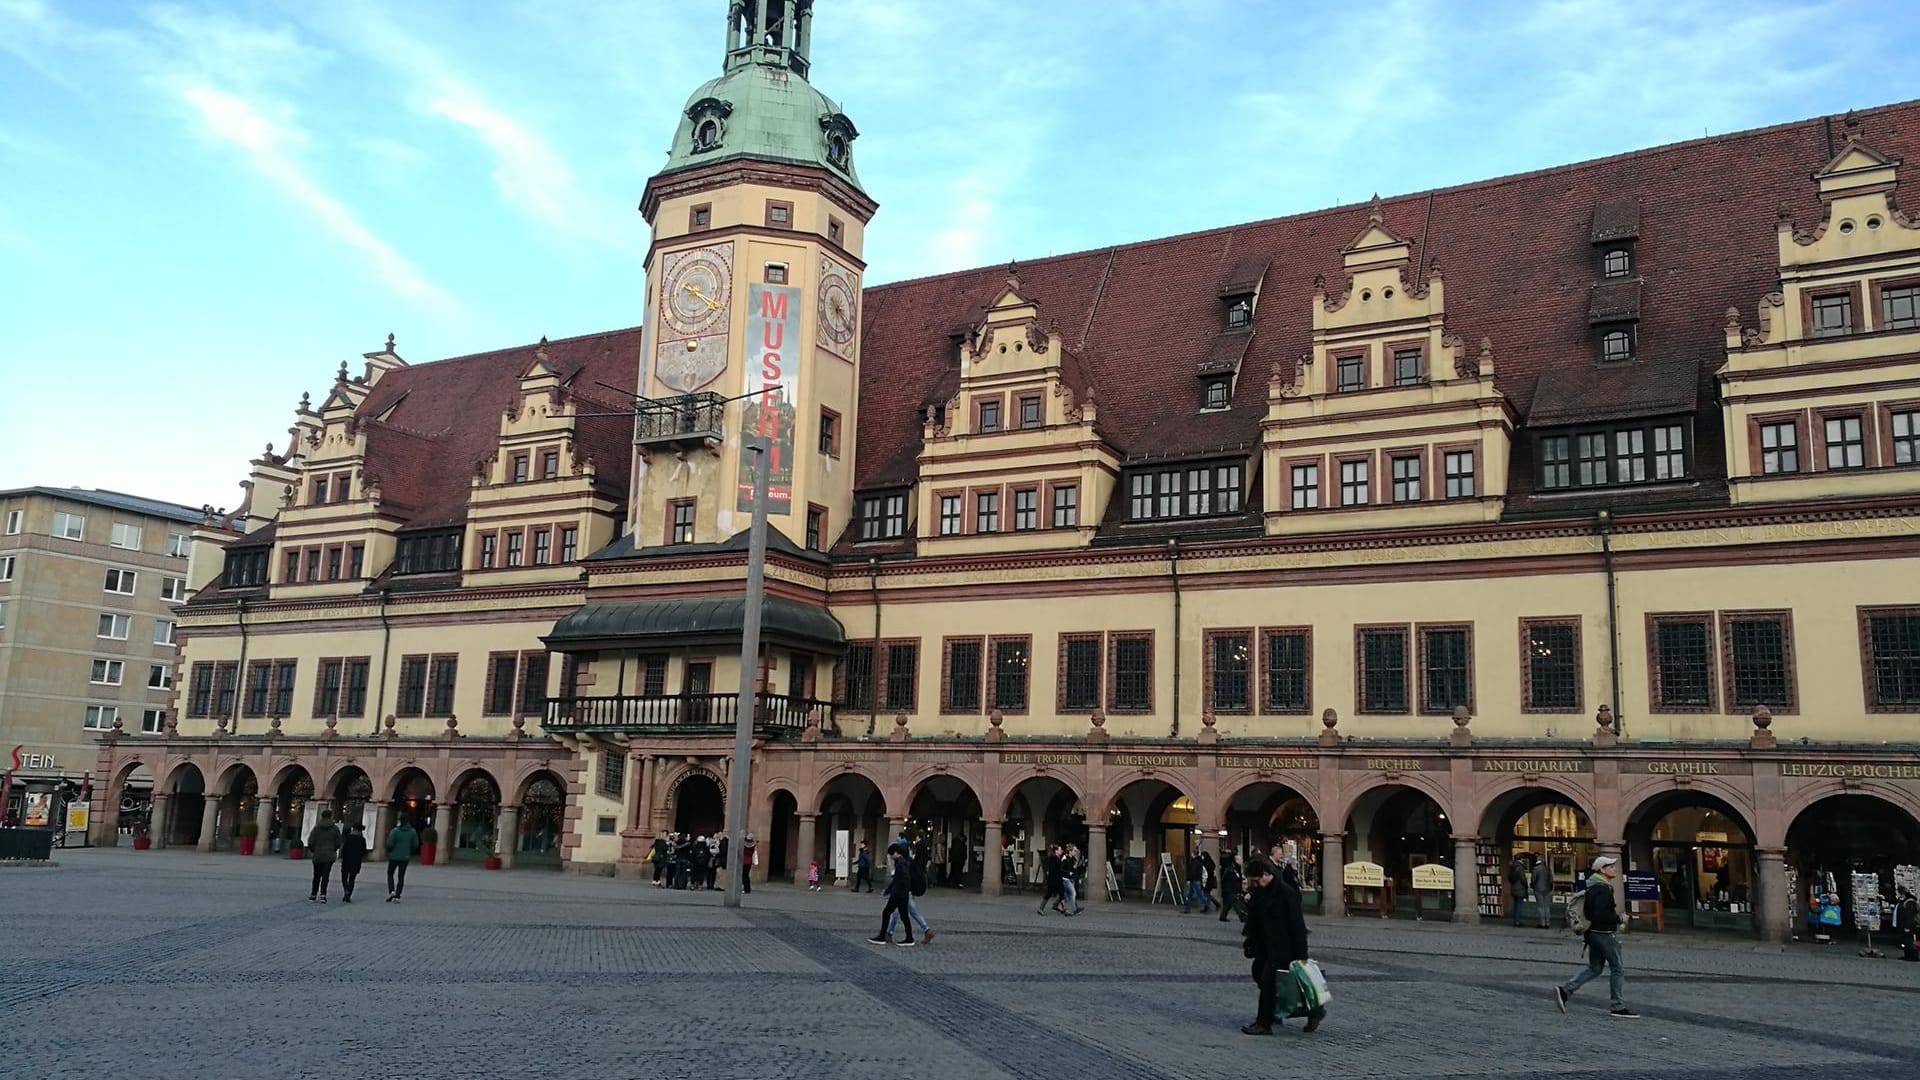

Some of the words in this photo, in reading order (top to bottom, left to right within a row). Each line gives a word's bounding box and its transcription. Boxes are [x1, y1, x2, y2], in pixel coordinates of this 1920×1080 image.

[11, 744, 55, 771] STEIN
[1004, 753, 1029, 764] EDLE
[1035, 753, 1082, 764] TROPFEN
[1114, 754, 1187, 767] AUGENOPTIK
[1217, 757, 1241, 767] TEE
[1243, 757, 1252, 767] &
[1484, 760, 1582, 772] ANTIQUARIAT
[1647, 761, 1718, 774] GRAPHIK
